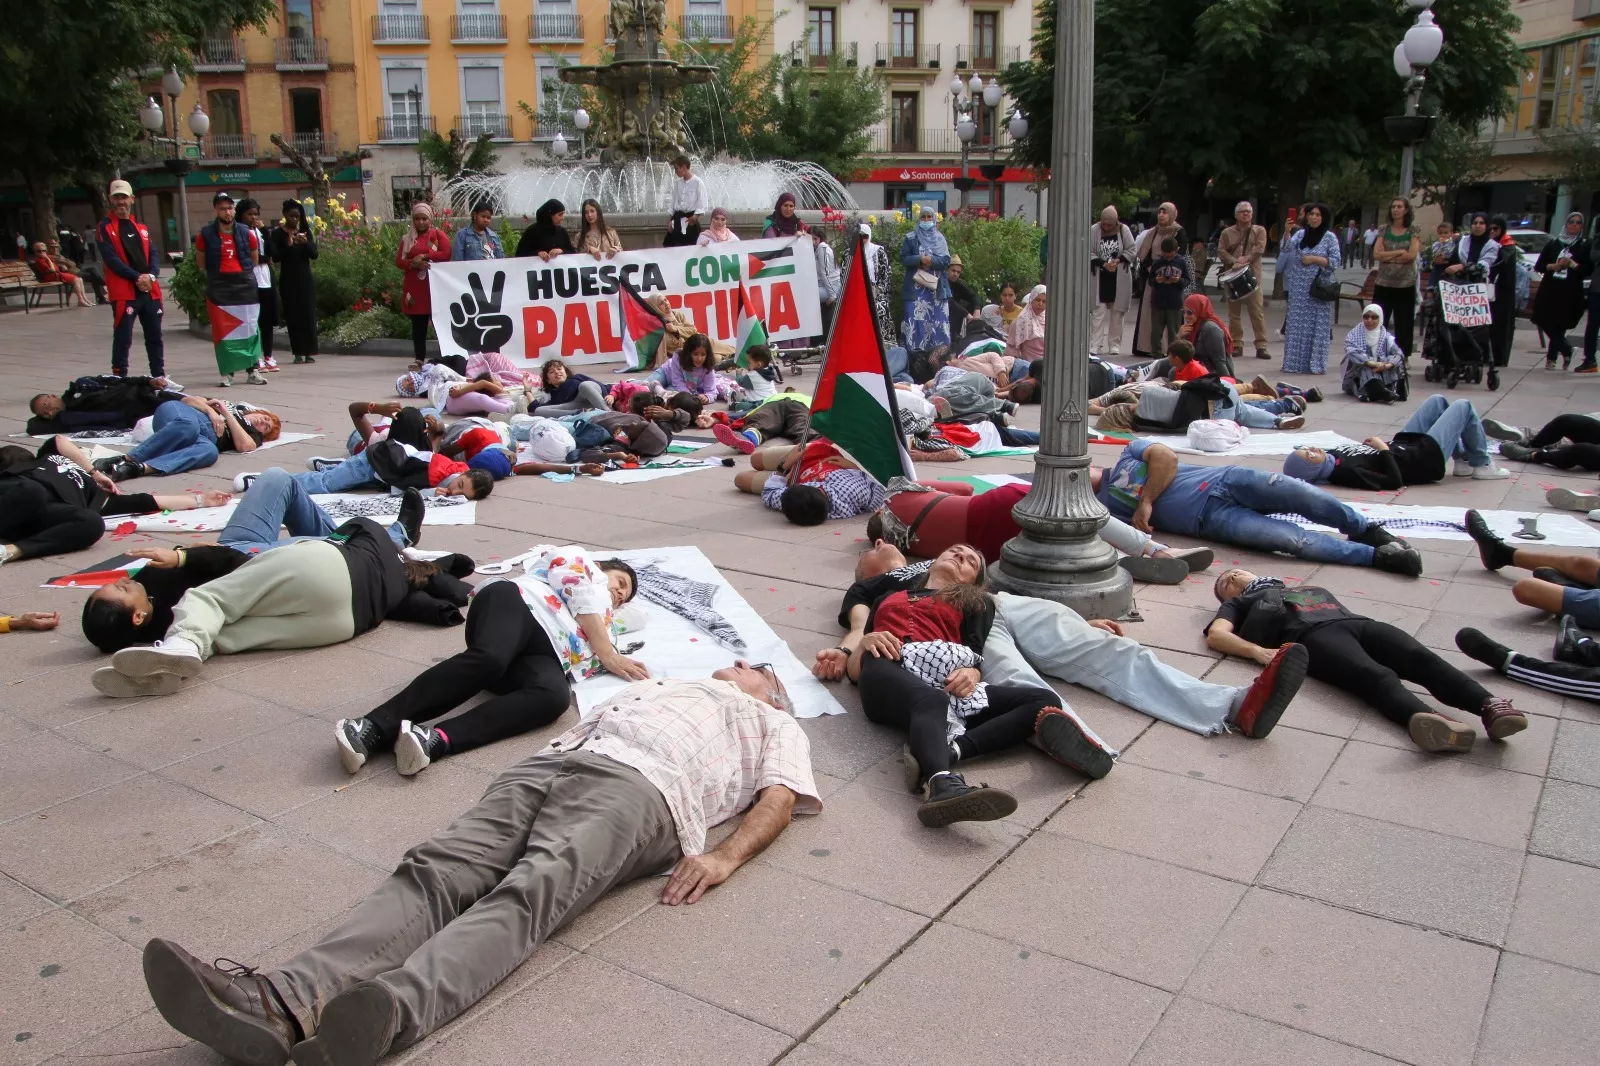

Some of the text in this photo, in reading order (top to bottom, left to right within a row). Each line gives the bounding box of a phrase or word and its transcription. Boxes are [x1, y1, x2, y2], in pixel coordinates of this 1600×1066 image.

[911, 171, 954, 180] Santander
[526, 254, 740, 301] HUESCA CON
[1441, 282, 1485, 296] ISRAEL
[1443, 291, 1487, 306] GENOCIDA
[522, 281, 800, 359] PALTINA
[1446, 313, 1490, 327] PATROCINA
